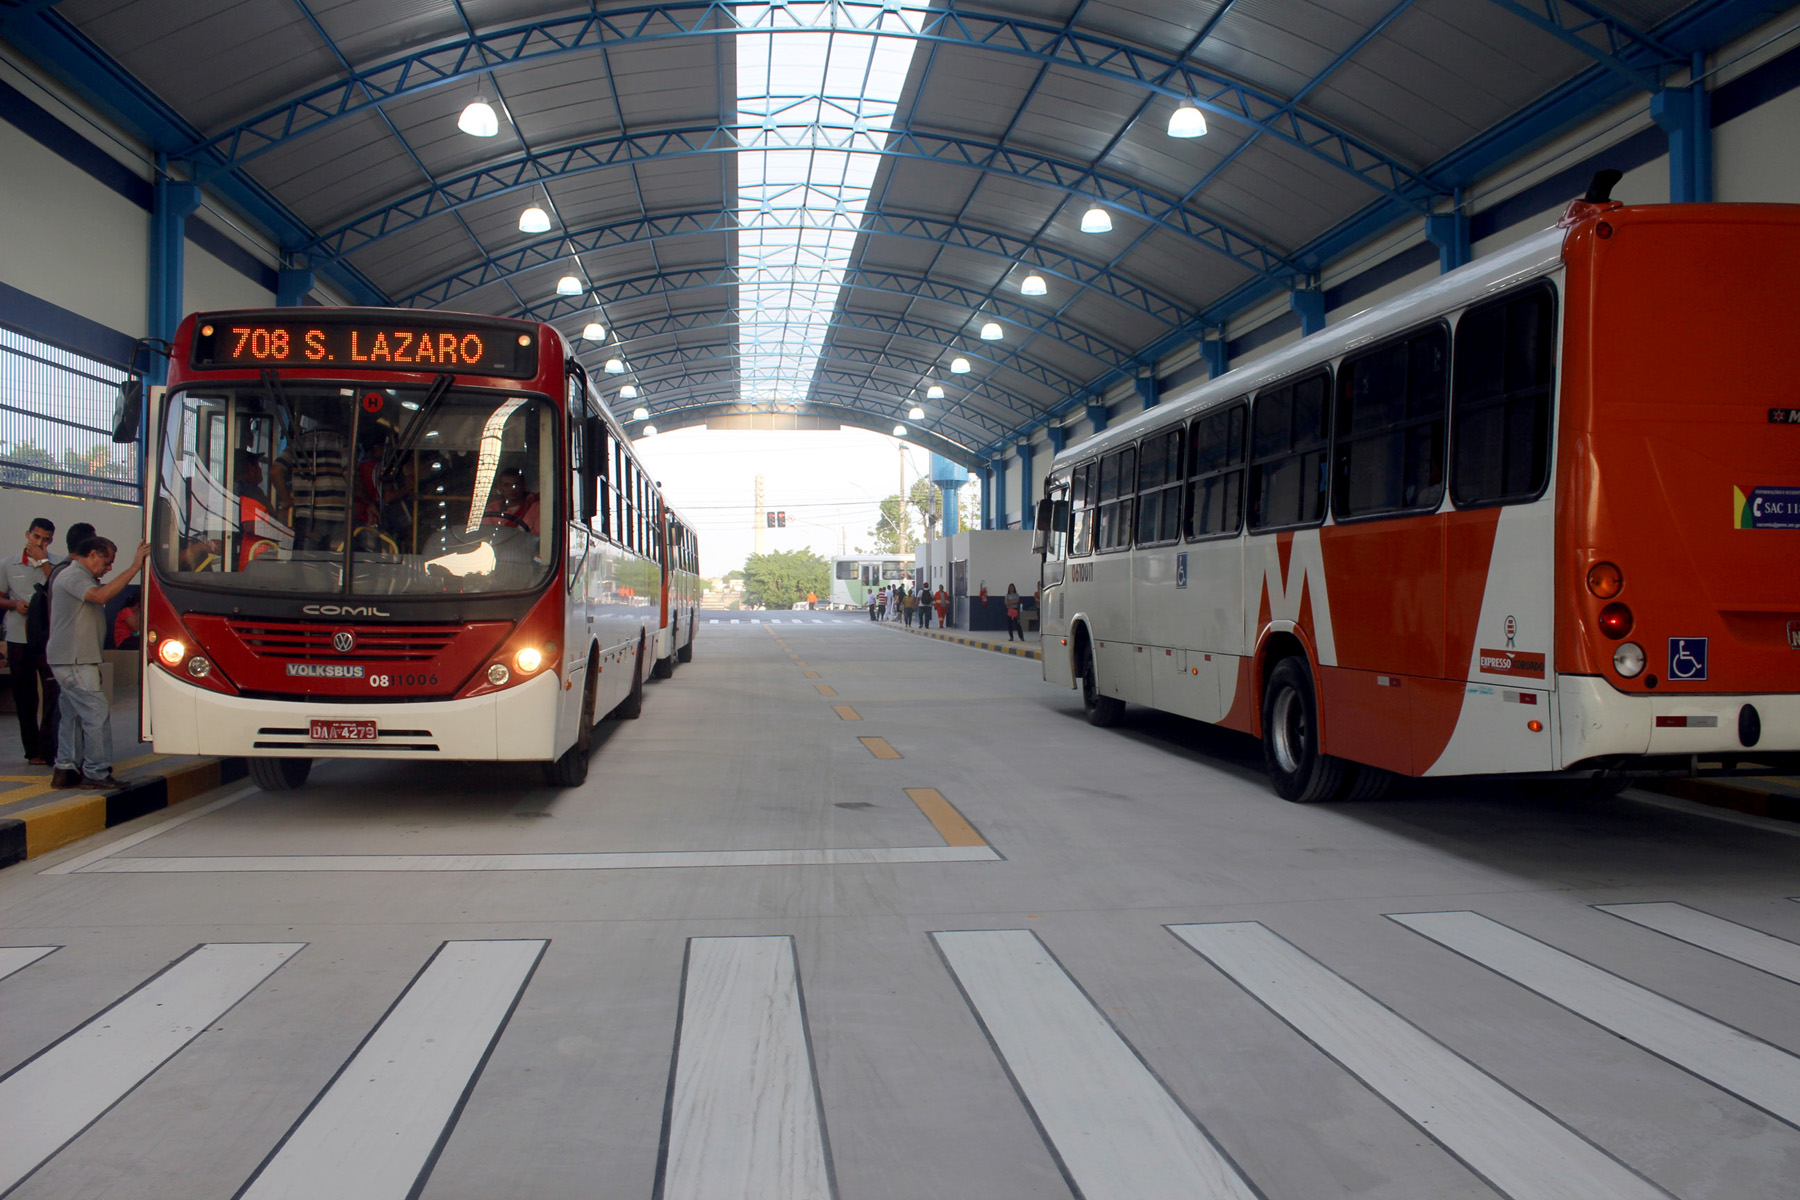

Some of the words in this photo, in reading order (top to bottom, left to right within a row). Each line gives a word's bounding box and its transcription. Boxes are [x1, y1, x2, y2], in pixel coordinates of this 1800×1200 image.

[232, 328, 289, 359] 708
[305, 330, 334, 360] S.
[351, 331, 483, 364] LAZARO
[1764, 502, 1784, 514] SAC
[1787, 503, 1800, 514] 11
[302, 604, 391, 617] COMIL
[1480, 656, 1512, 669] EXPRESSO
[288, 664, 363, 677] VOLKSBUS
[369, 673, 439, 687] 0811006
